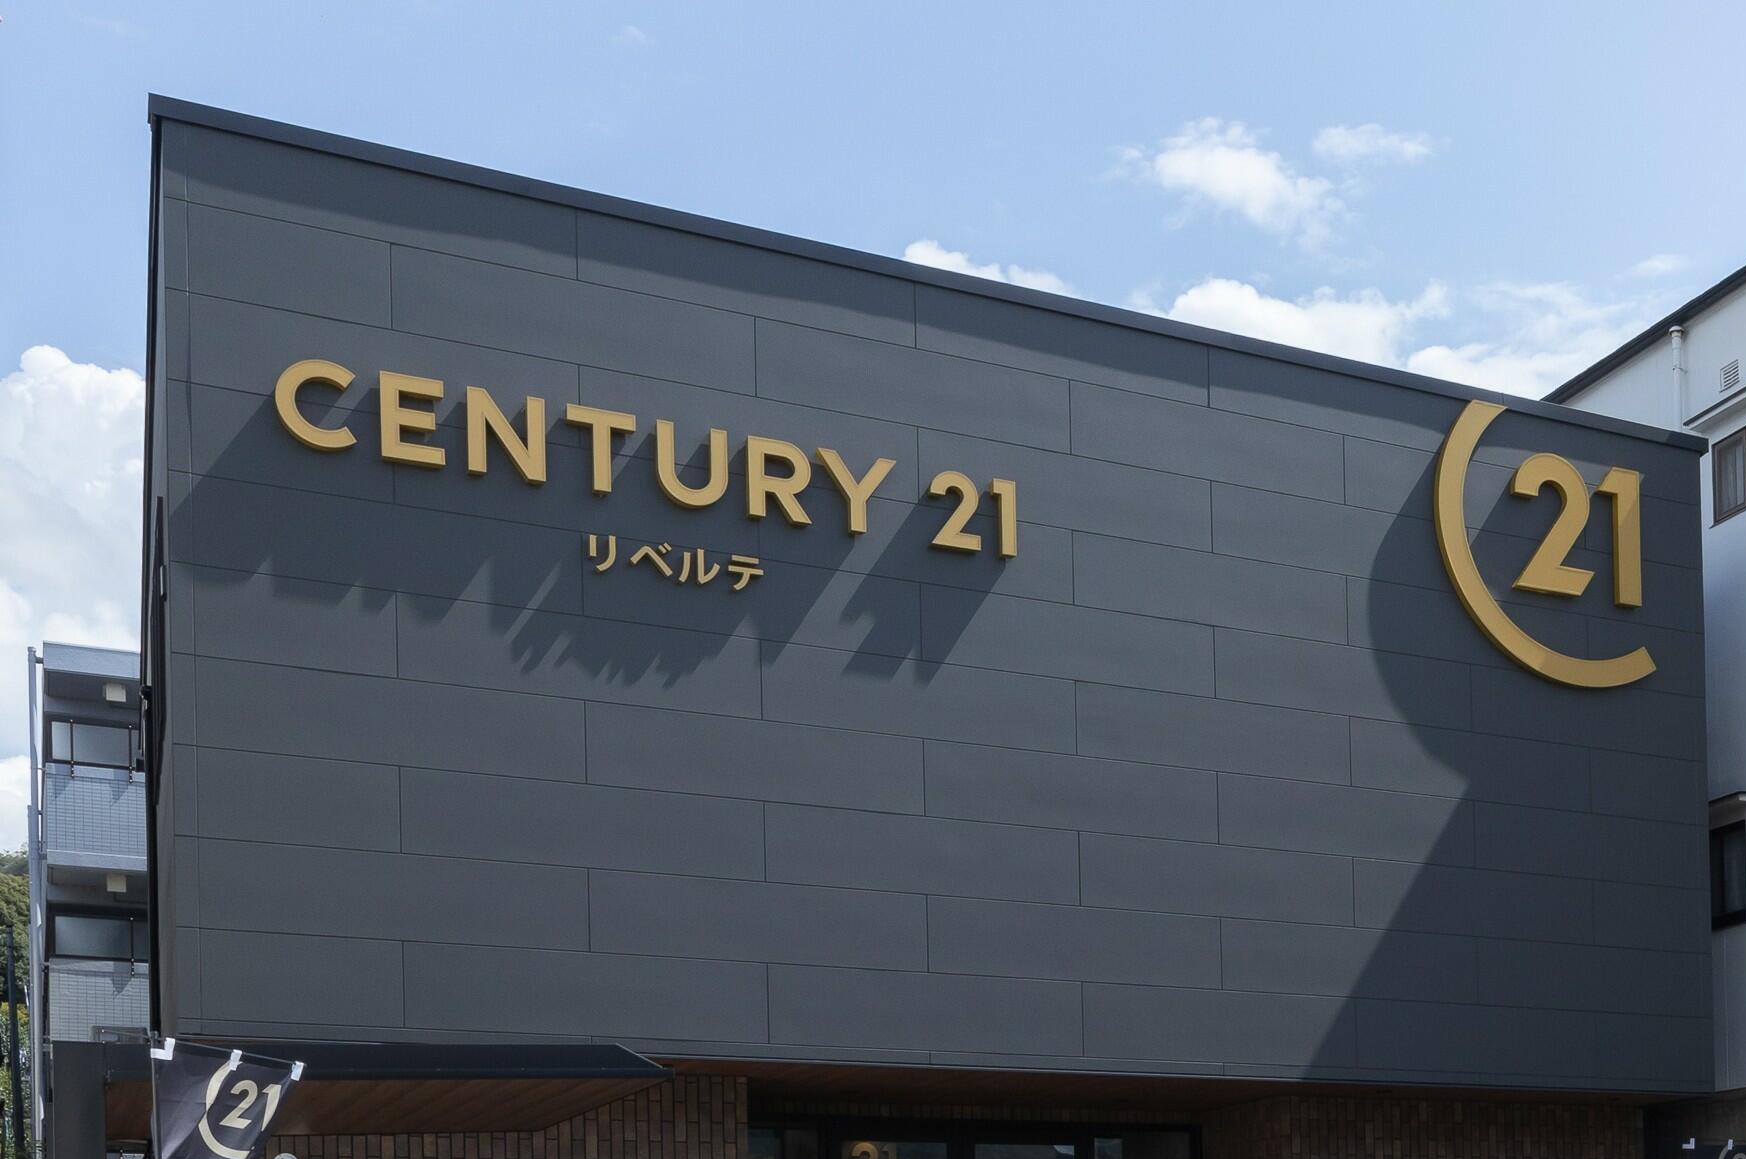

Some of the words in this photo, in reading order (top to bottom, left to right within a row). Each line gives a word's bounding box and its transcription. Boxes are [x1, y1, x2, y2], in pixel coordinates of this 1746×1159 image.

[274, 358, 897, 535] CENTURY
[929, 469, 1018, 559] 21
[587, 534, 765, 592] リベルテ
[219, 1079, 282, 1132] 21
